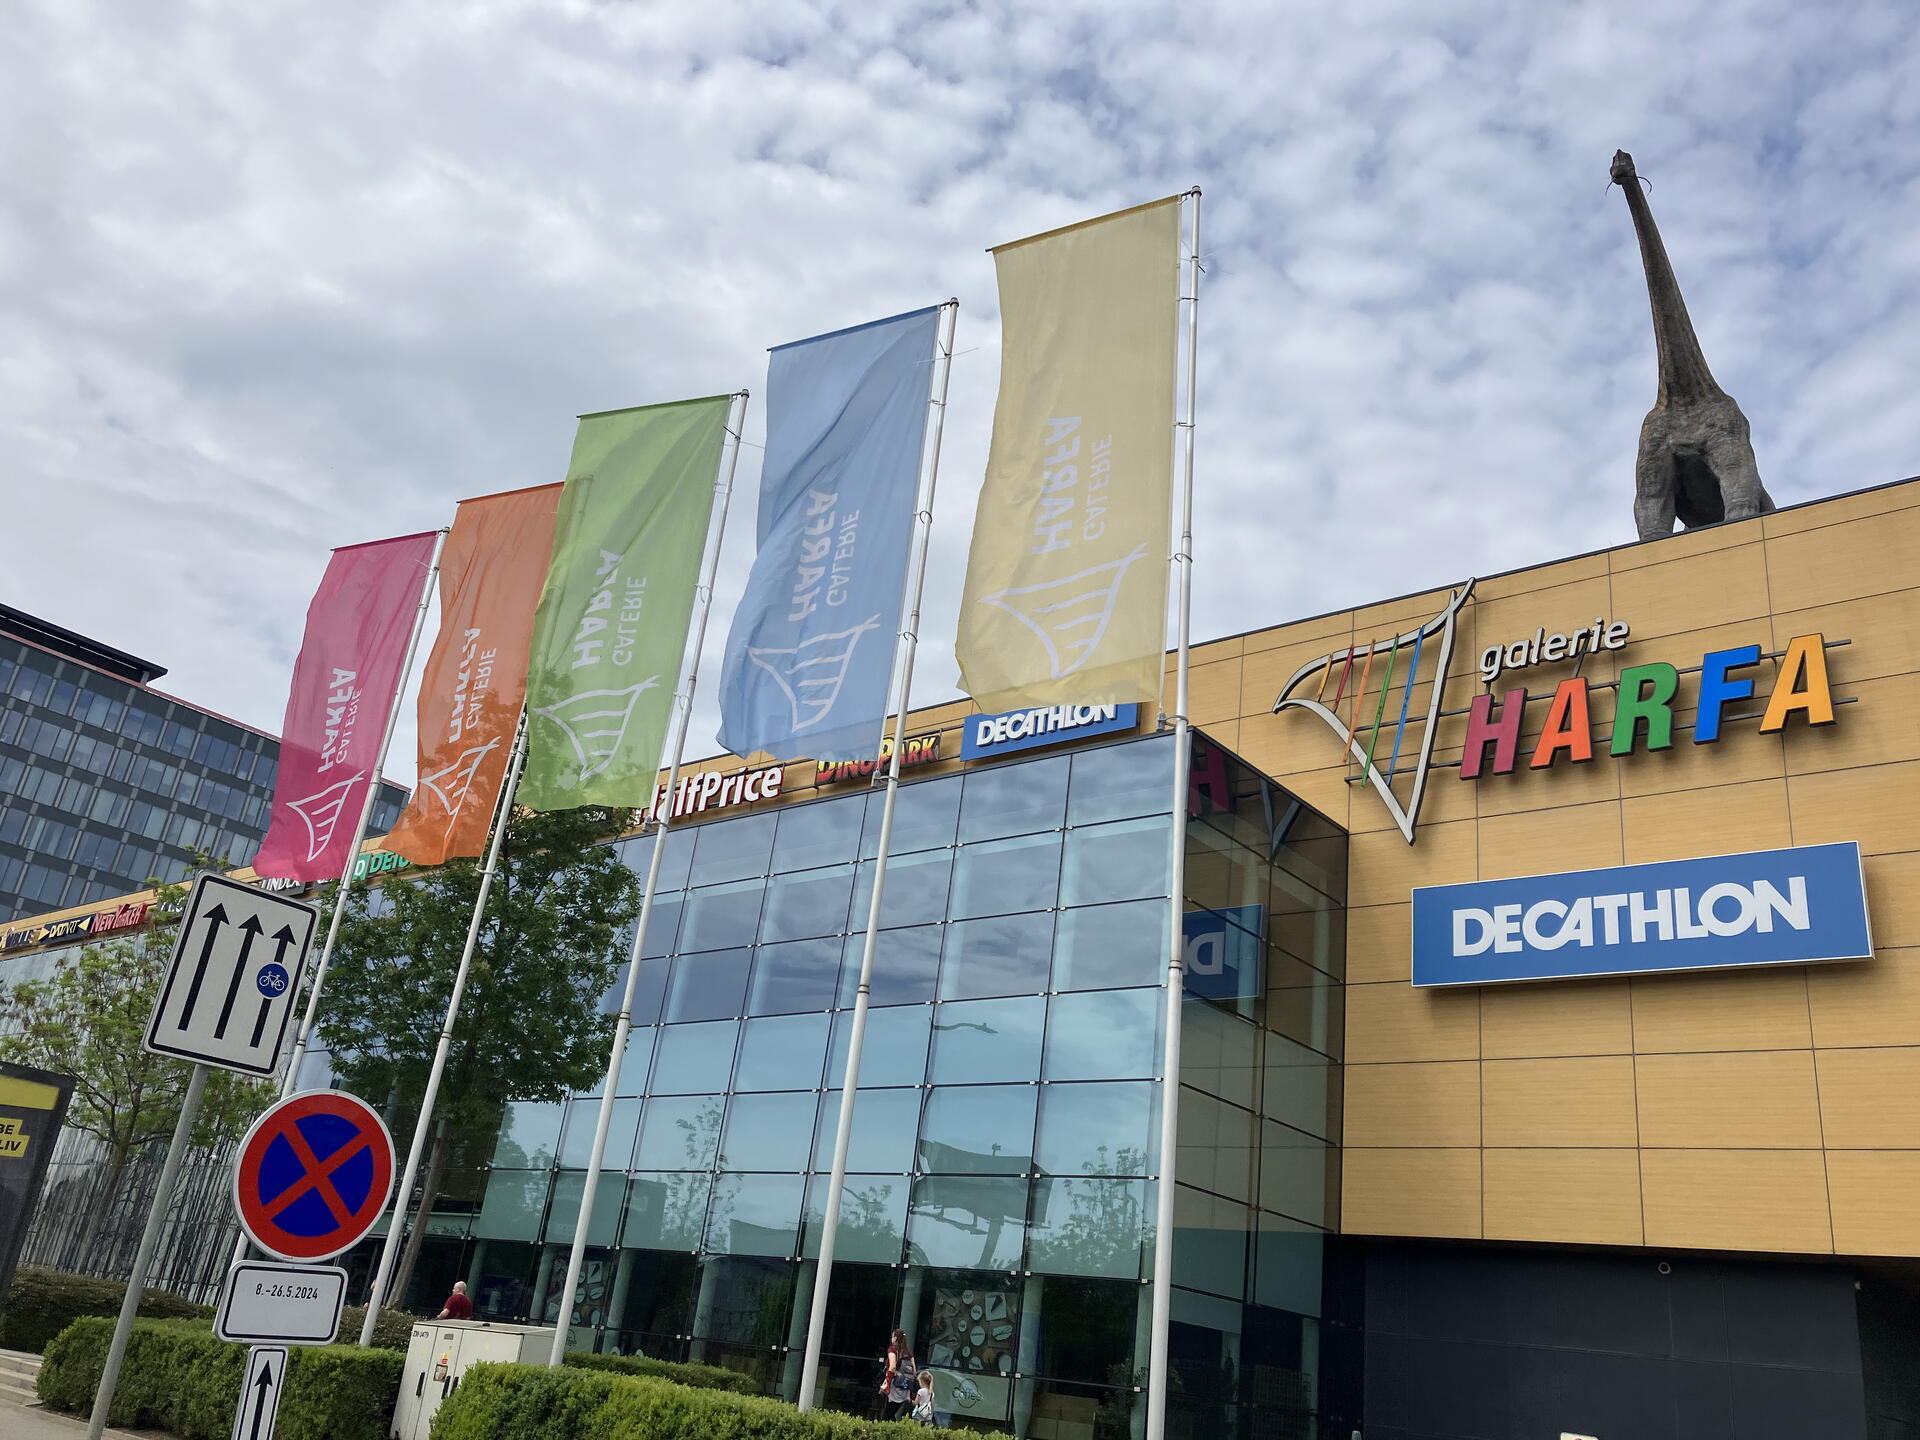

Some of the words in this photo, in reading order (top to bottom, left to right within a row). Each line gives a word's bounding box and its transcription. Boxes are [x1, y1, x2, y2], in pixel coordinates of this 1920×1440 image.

[1479, 616, 1631, 683] galerie
[976, 701, 1117, 748] DECATHLON
[1460, 632, 1836, 780] HARFA
[1451, 875, 1811, 958] DECATHLON
[255, 1282, 319, 1300] 8.-26.5.2024
